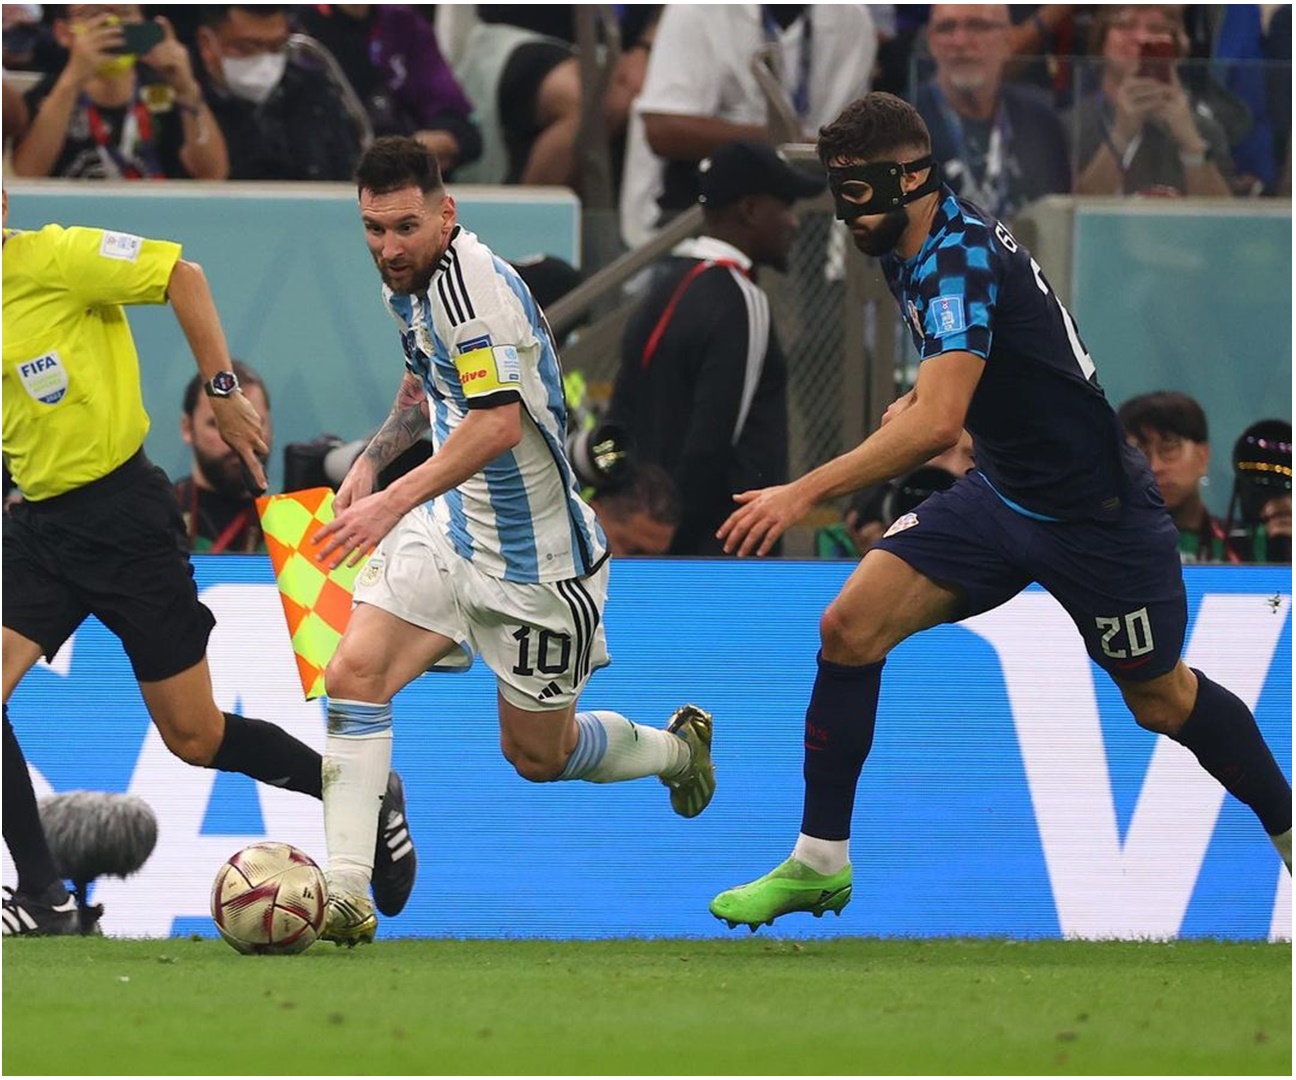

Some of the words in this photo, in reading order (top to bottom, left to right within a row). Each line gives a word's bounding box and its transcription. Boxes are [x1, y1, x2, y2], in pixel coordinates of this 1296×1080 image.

[20, 355, 57, 378] FIFA
[512, 625, 571, 677] 10
[1095, 607, 1154, 658] 20
